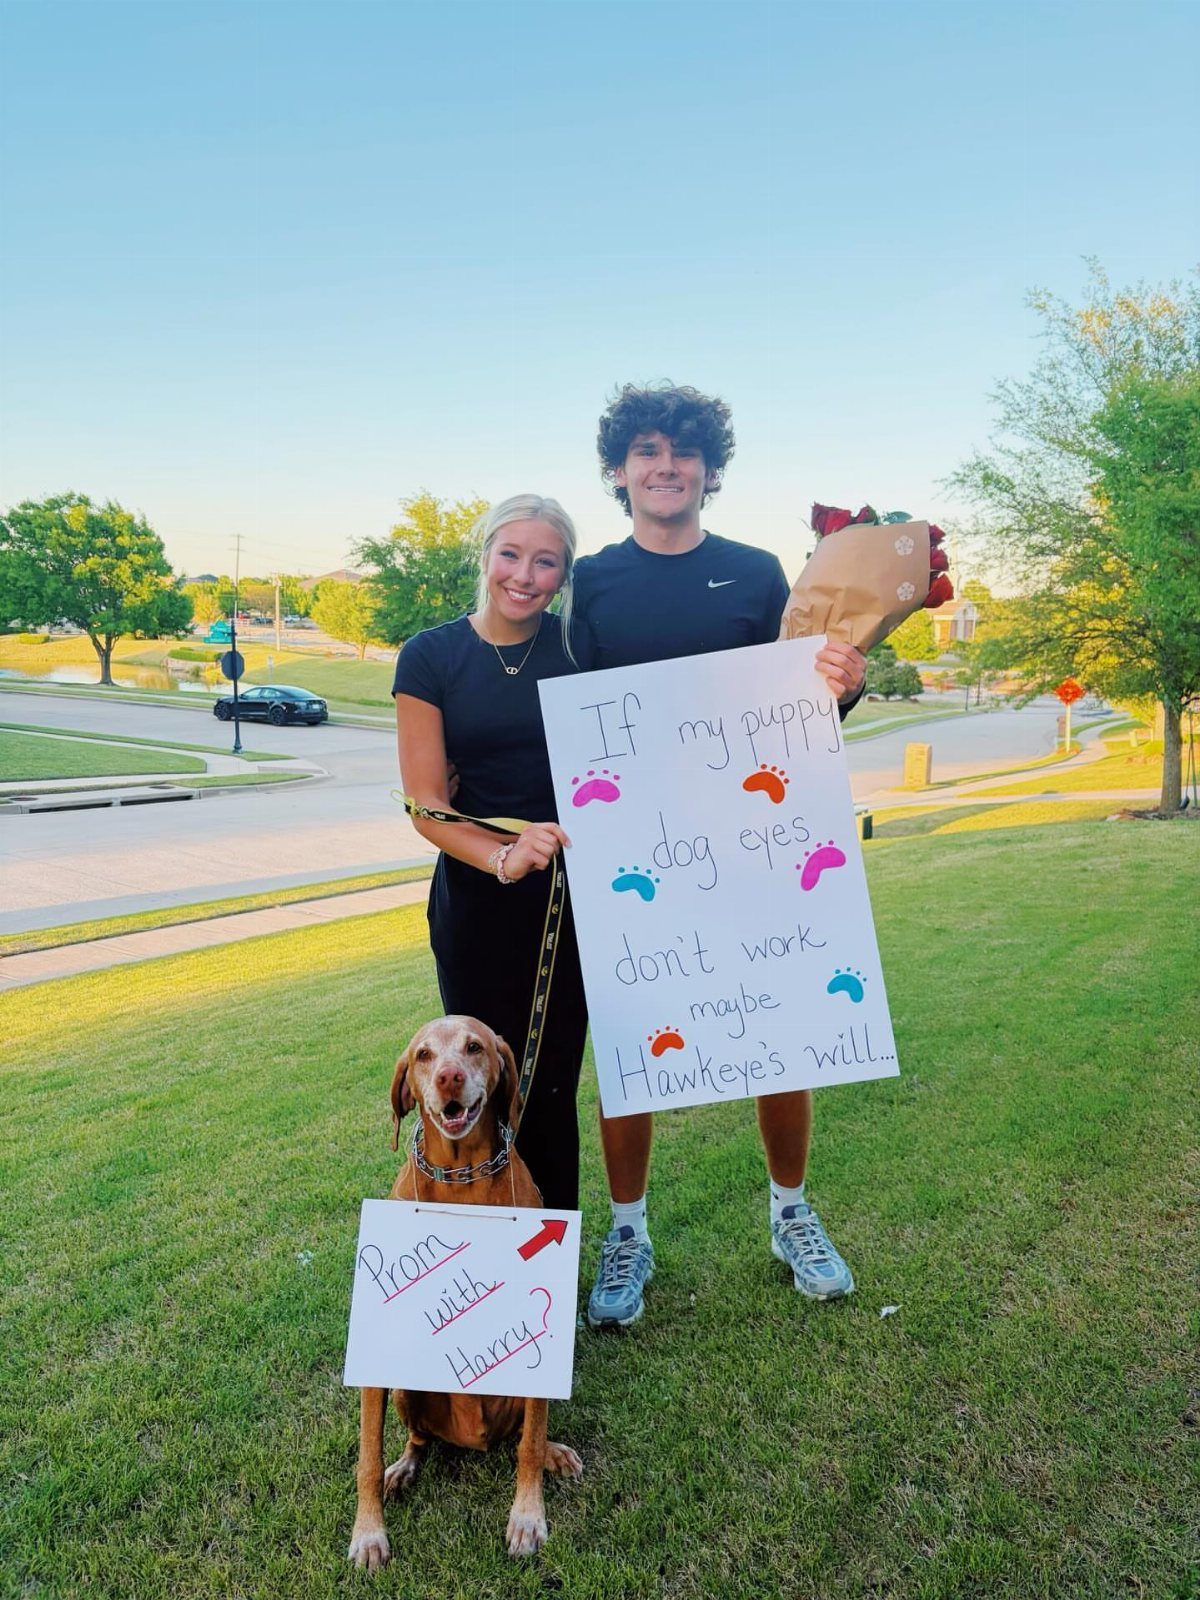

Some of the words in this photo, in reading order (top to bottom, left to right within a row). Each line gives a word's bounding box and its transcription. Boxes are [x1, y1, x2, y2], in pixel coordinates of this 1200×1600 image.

[580, 692, 641, 762] If
[678, 717, 730, 770] my
[740, 697, 840, 767] puppy
[652, 811, 718, 890] dog
[739, 816, 810, 870] eyes
[615, 930, 715, 985] don't
[741, 924, 827, 962] work
[689, 982, 781, 1039] maybe
[615, 1041, 786, 1101] Hawkeye's
[803, 1023, 895, 1069] will...
[358, 1234, 465, 1299] Prom
[423, 1268, 497, 1331] with
[445, 1287, 554, 1388] Harry?
